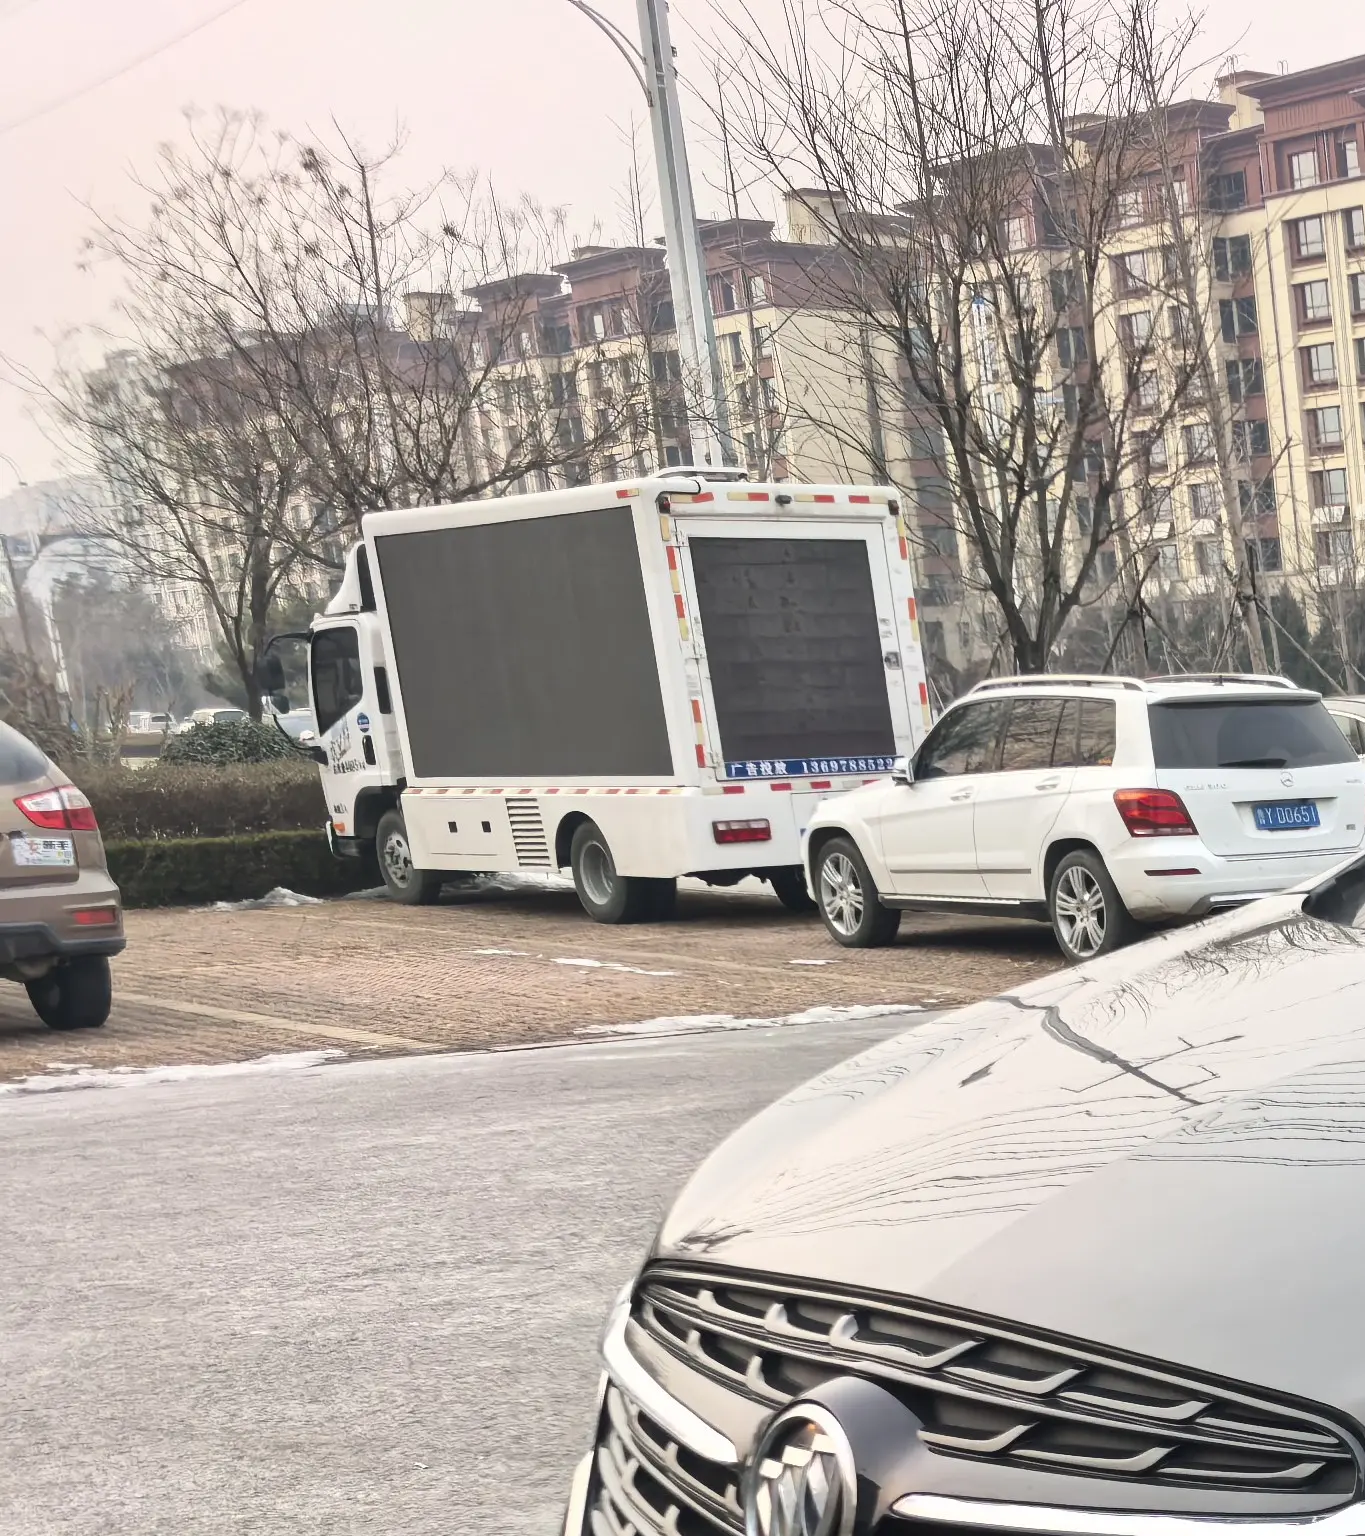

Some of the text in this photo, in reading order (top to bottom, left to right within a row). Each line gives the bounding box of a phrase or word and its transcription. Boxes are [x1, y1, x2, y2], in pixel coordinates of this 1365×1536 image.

[731, 758, 895, 777] 广告投放 1369788522
